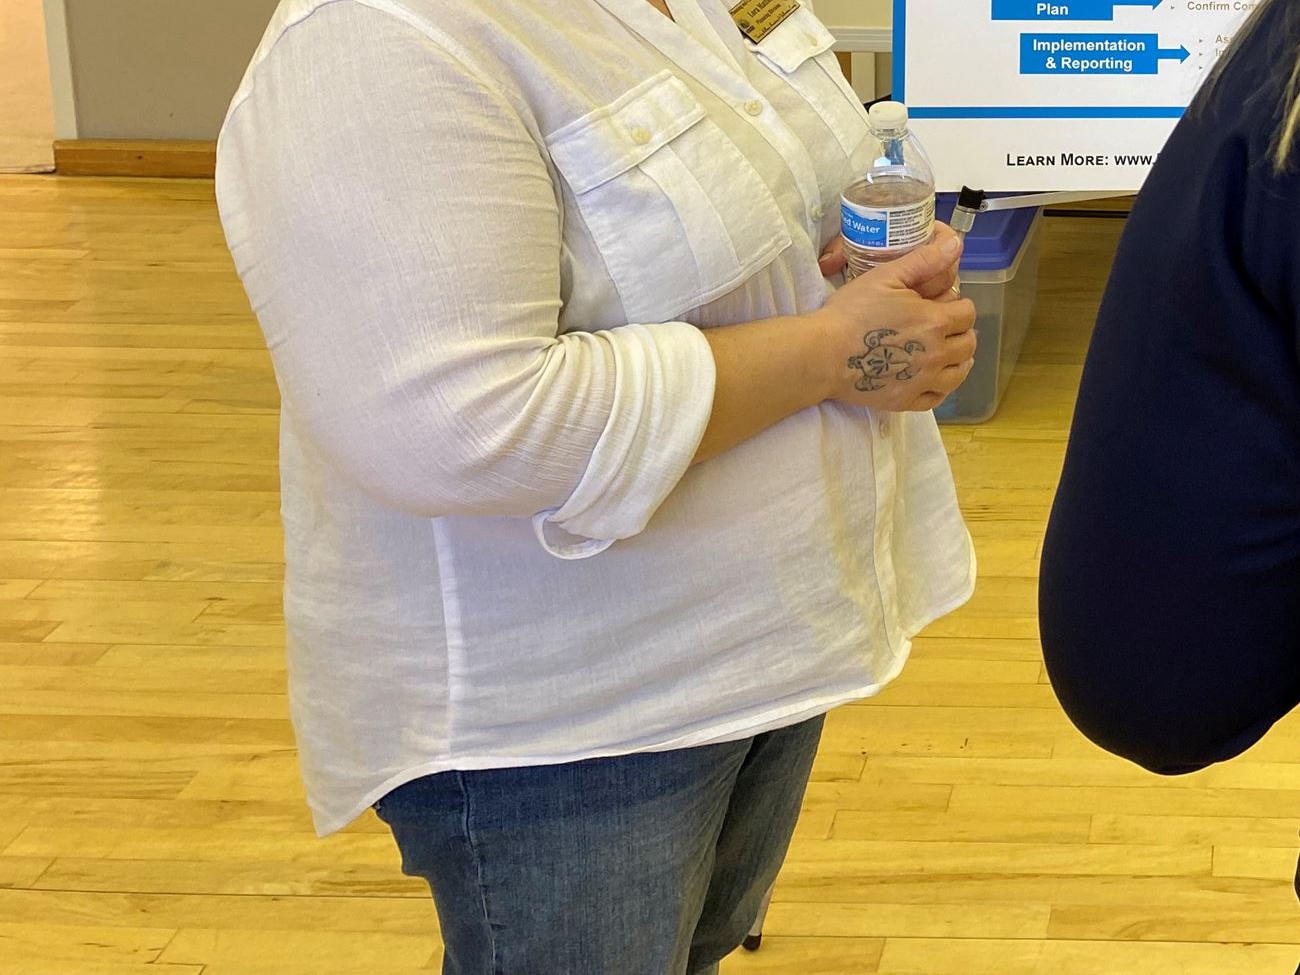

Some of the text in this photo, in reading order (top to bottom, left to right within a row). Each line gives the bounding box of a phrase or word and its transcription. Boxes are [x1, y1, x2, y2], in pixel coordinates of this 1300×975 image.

[1036, 2, 1069, 17] Plan
[1187, 1, 1230, 11] Confirm
[1032, 37, 1146, 54] Implementation
[1045, 55, 1133, 73] & Reporting
[852, 220, 880, 233] Water
